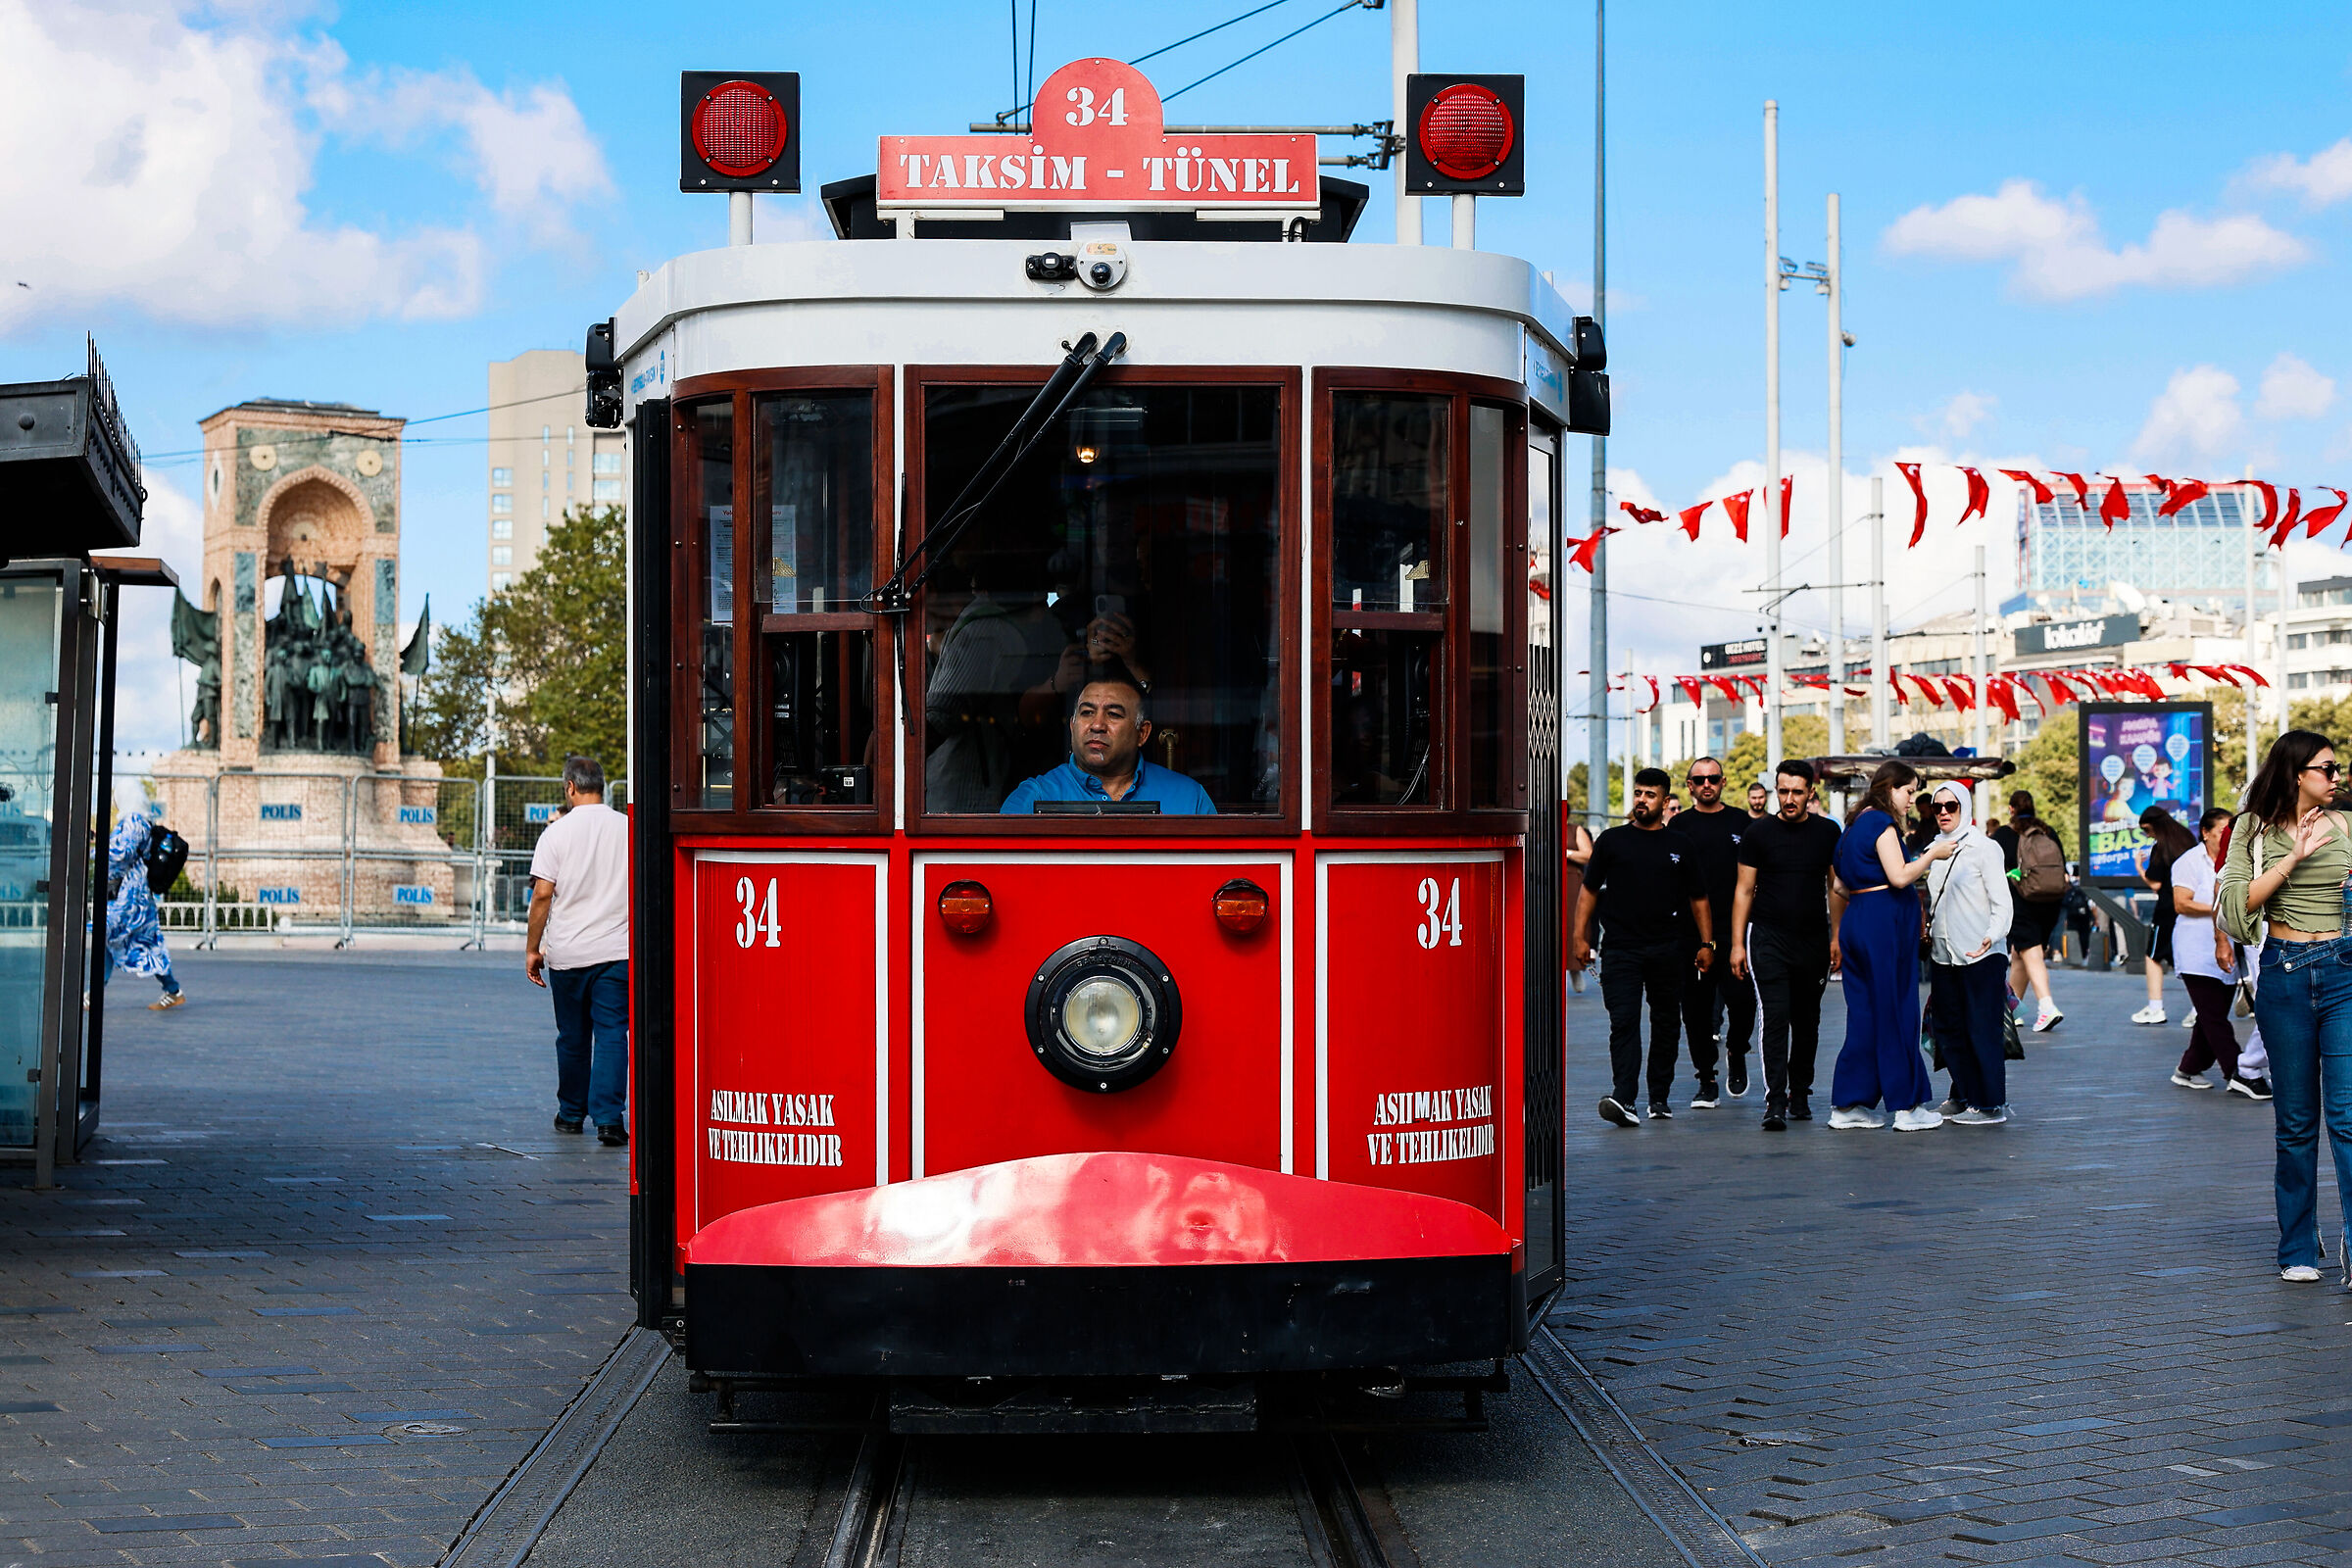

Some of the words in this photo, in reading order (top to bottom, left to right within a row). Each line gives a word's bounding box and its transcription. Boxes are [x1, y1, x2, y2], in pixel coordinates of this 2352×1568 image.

[1065, 86, 1129, 127] 34
[900, 144, 1088, 190] TAKSİM
[1143, 145, 1299, 194] TÜNEL
[262, 804, 302, 820] POLİS
[400, 808, 433, 823] POLİS
[259, 887, 300, 904] POLİS
[397, 887, 432, 904] POLİS
[736, 876, 782, 949] 34
[1417, 877, 1463, 950] 34
[710, 1089, 769, 1125] ASILMAK
[771, 1093, 835, 1126] YASAK
[1454, 1085, 1493, 1120] YASAK
[708, 1127, 721, 1160] VE
[722, 1129, 843, 1166] TEHLIKELIDIR
[1367, 1133, 1393, 1165] VE
[1396, 1124, 1494, 1164] TEHLIKELIDIR
